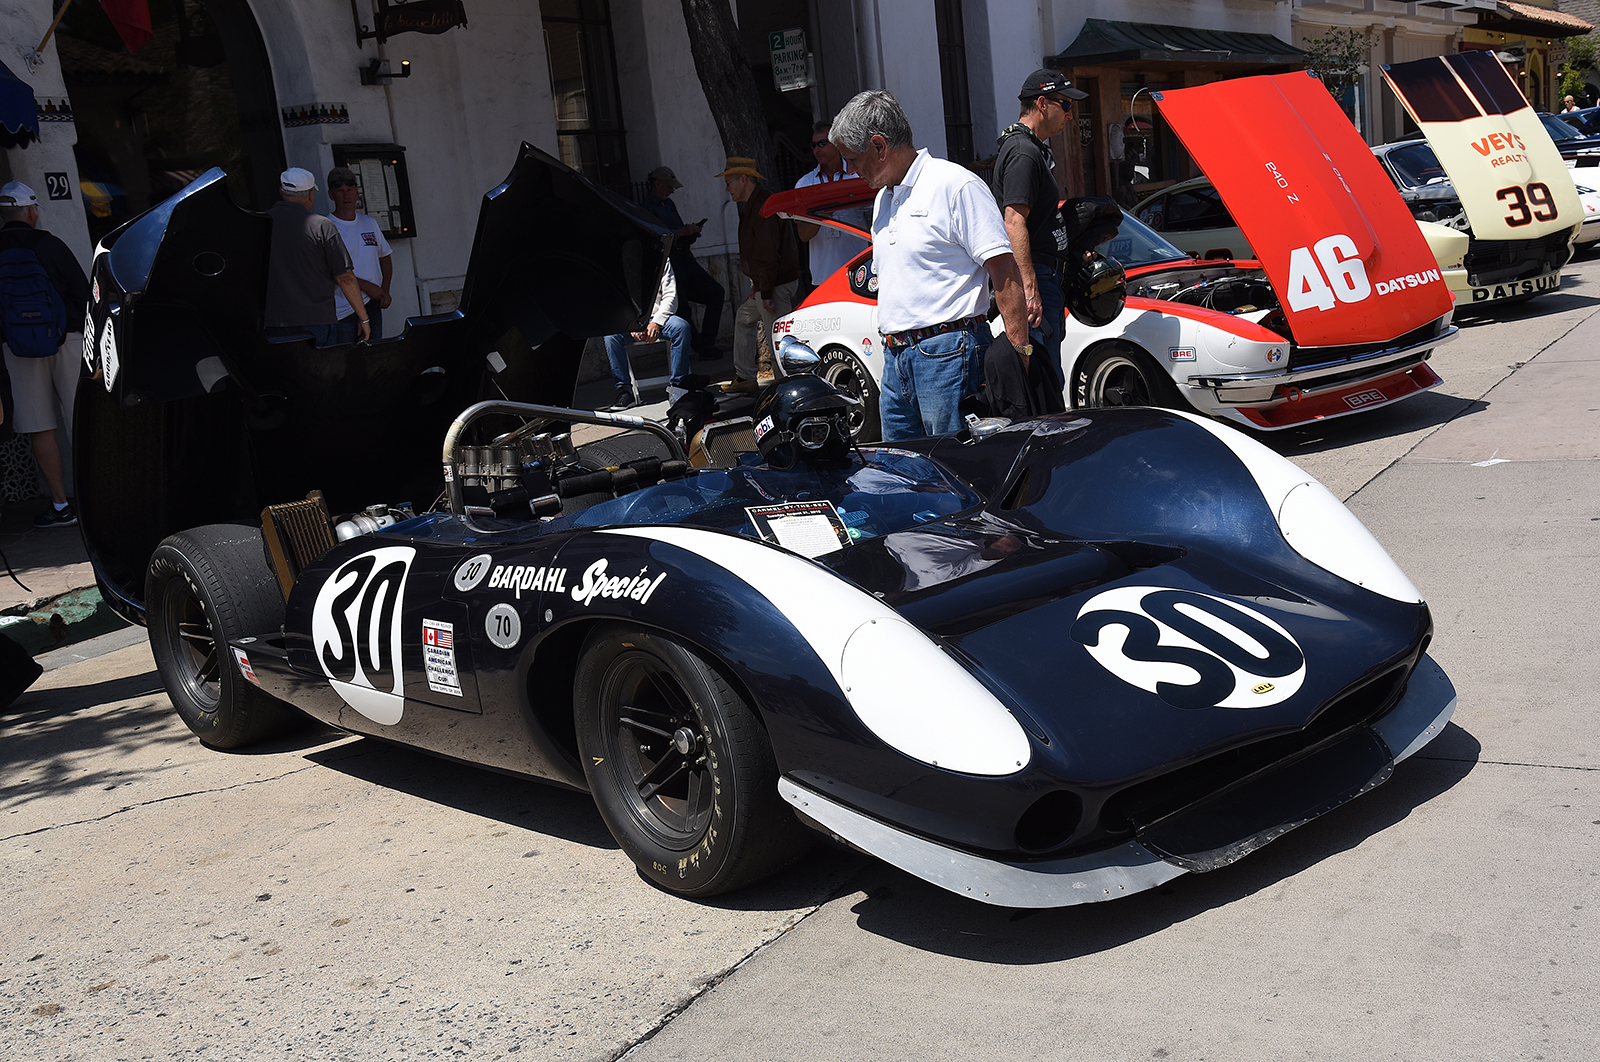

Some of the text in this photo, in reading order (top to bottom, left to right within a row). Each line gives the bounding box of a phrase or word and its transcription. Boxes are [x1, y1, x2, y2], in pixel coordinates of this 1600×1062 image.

[773, 35, 803, 48] 2 HOUR
[774, 50, 804, 64] PARKING
[1471, 133, 1526, 156] VEYS
[1491, 154, 1528, 168] REALTY
[48, 176, 68, 197] 29
[1265, 161, 1300, 204] 240 Z
[1496, 182, 1558, 228] 39
[1287, 234, 1371, 313] 46
[1375, 269, 1440, 296] DATSUN
[1472, 275, 1557, 302] DATSUN
[773, 321, 792, 333] BRE
[794, 318, 841, 333] DATSUN
[1172, 350, 1192, 358] BRE
[1348, 391, 1382, 406] BRE
[461, 562, 482, 580] 30
[488, 558, 667, 606] BARDAHL Special
[322, 555, 407, 692] 30
[495, 615, 511, 637] 70
[427, 648, 450, 656] CANADIAN
[1069, 590, 1304, 710] 30
[428, 657, 452, 665] AMERICAN
[428, 665, 455, 675] CHALLENGE
